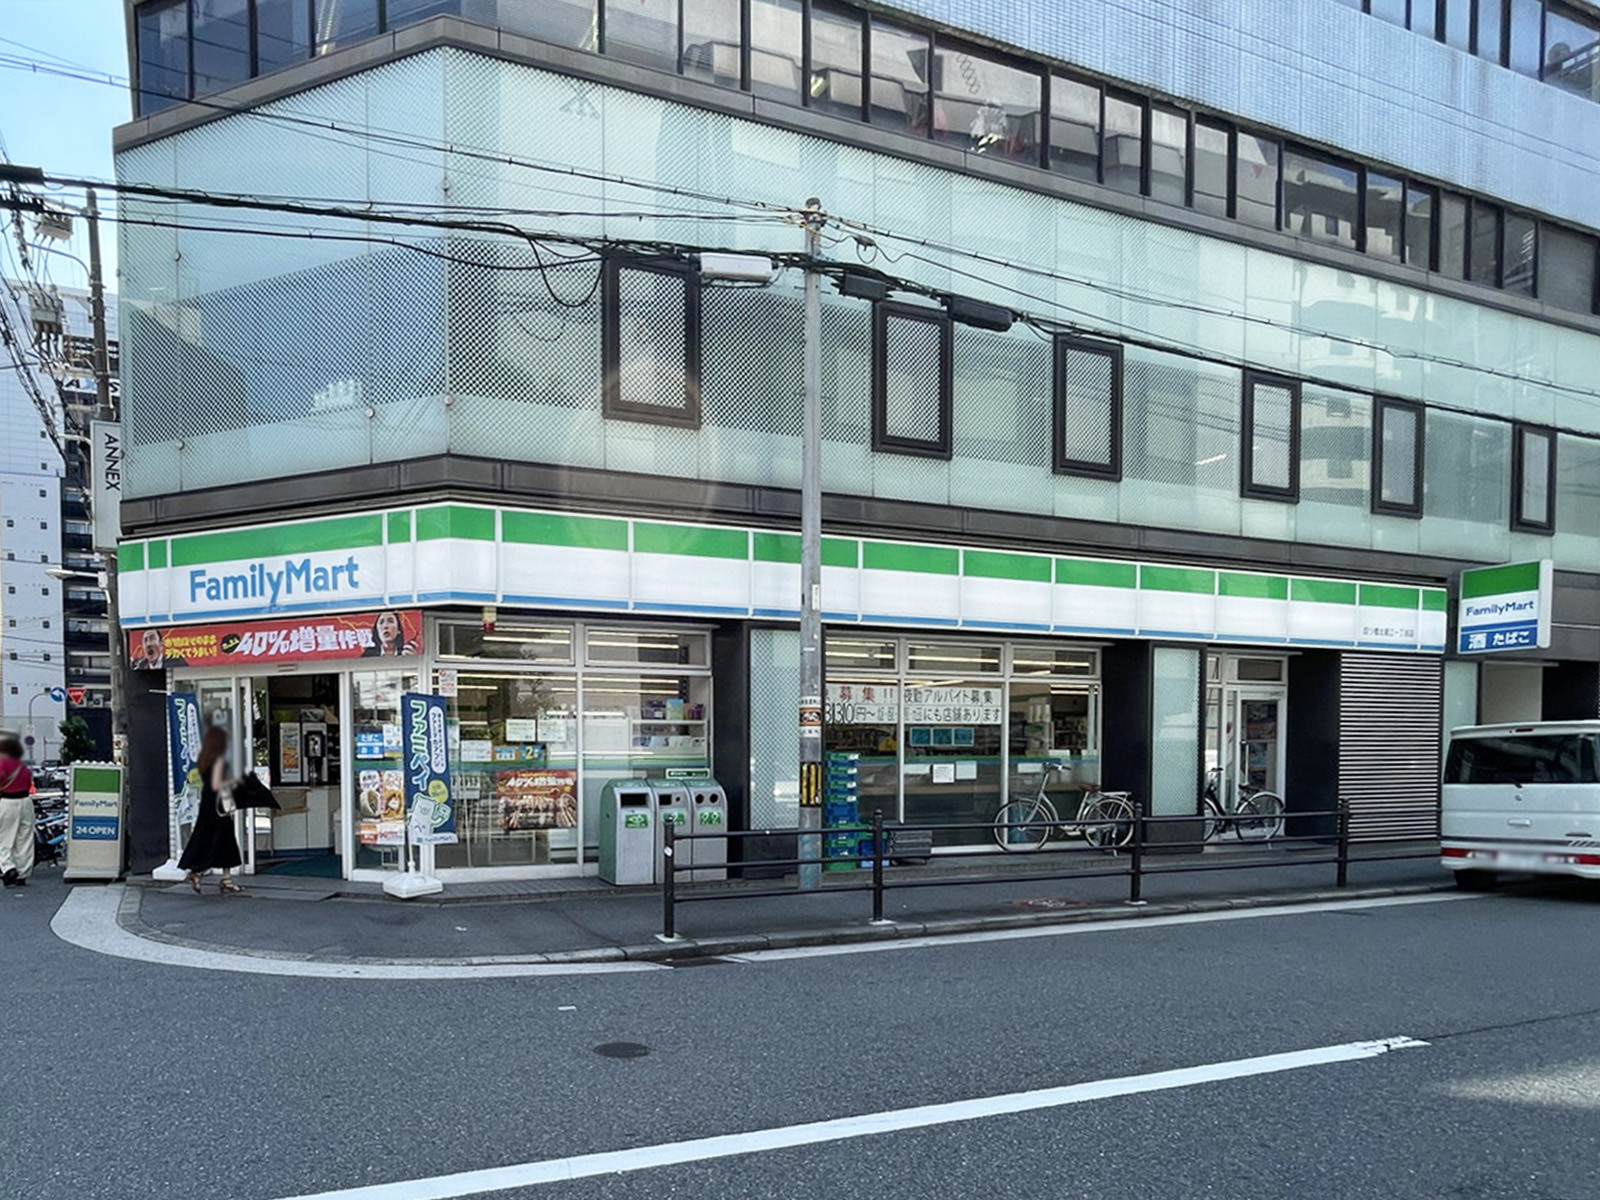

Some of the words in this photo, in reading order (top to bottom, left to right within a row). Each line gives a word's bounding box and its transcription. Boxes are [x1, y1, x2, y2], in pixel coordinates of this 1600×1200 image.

[104, 432, 121, 491] ANNEX
[189, 555, 359, 607] FamilyMart
[1466, 600, 1534, 616] FamilyMart
[1468, 633, 1487, 649] 酒
[1492, 630, 1530, 646] たばこ
[825, 685, 893, 703] 募集!!
[75, 826, 87, 835] 24
[88, 826, 116, 835] OPEN
